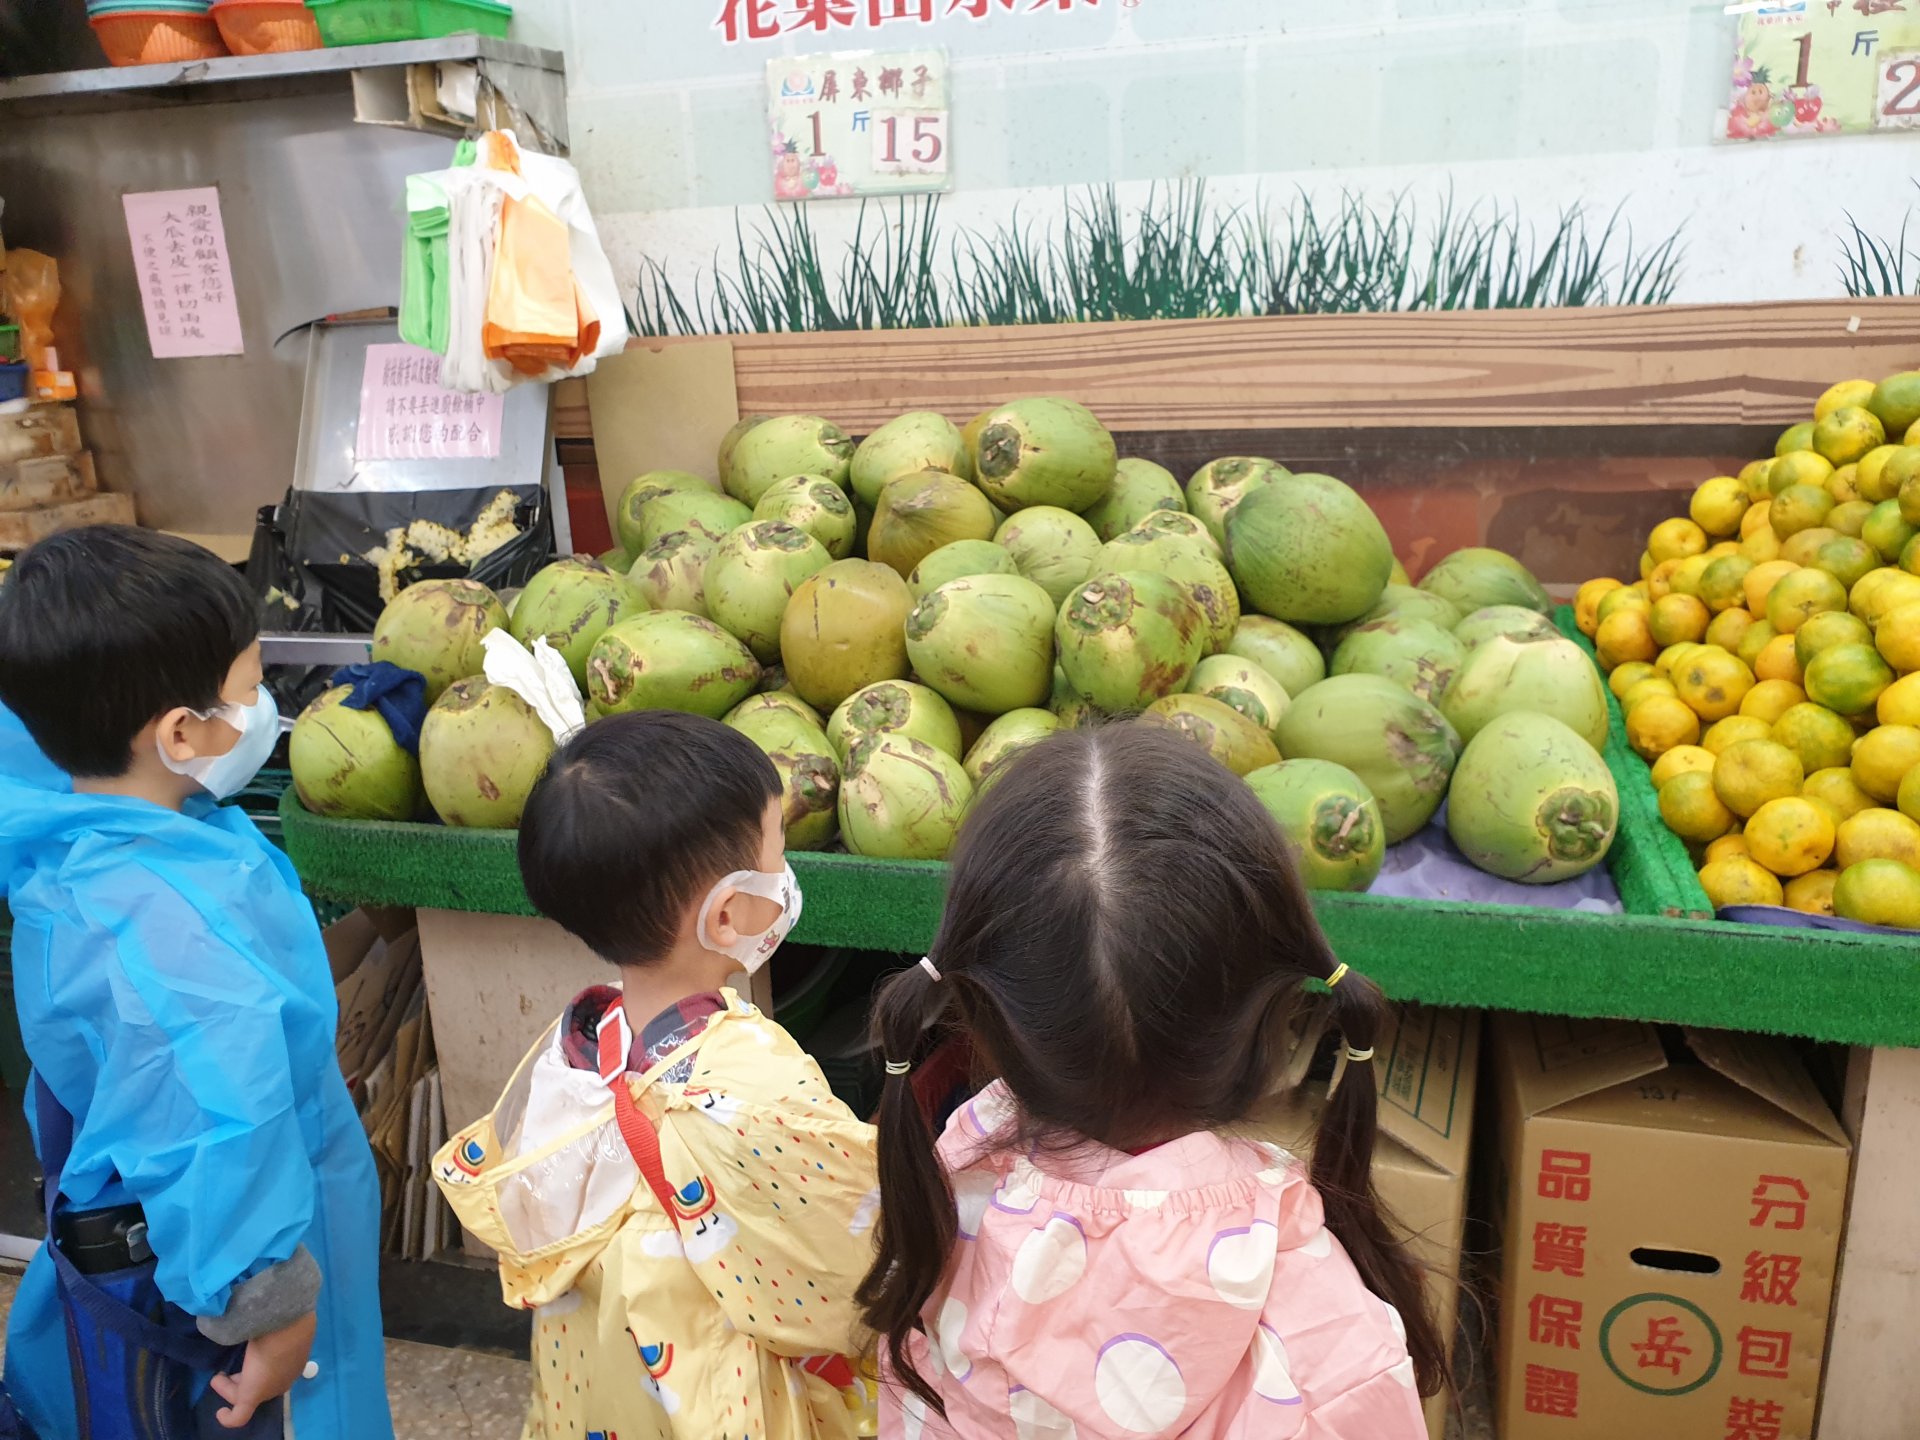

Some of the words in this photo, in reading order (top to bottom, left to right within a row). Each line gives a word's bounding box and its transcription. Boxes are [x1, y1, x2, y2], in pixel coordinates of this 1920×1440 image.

[818, 64, 933, 104] 屏東椰子
[1789, 32, 1813, 88] 1
[1851, 30, 1879, 56] 斤
[807, 111, 827, 157] 1
[852, 110, 870, 132] 斤
[880, 116, 942, 163] 15
[186, 204, 225, 303] 親愛的顧客您好
[1524, 1148, 1591, 1418] 品質保證
[1724, 1174, 1810, 1440] 分級包裝
[1631, 1316, 1692, 1376] 岳
